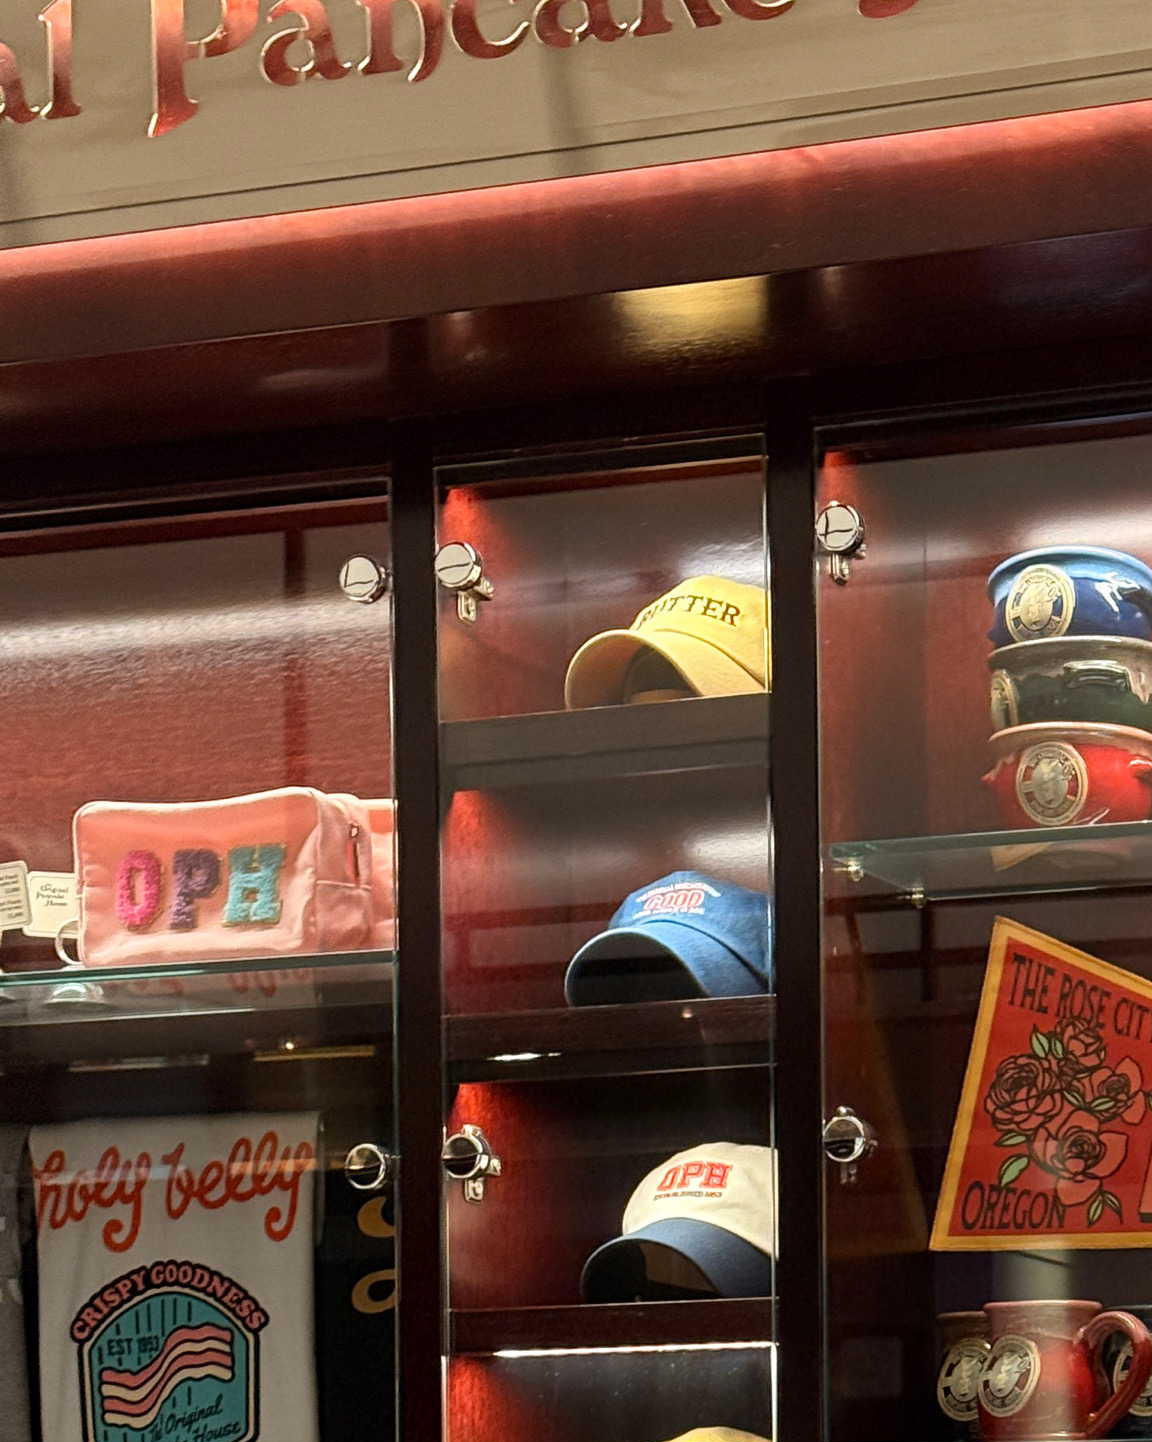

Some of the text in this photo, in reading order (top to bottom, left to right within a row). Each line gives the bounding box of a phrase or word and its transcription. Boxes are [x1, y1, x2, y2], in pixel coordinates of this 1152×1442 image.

[145, 0, 796, 137] Panca
[636, 594, 741, 632] BUTTER
[115, 843, 287, 933] OPH
[643, 888, 706, 911] GOOD
[1007, 953, 1050, 1012] THE
[1055, 978, 1110, 1026] ROSE
[33, 1146, 152, 1254] holy
[161, 1130, 315, 1243] belly
[656, 1161, 733, 1191] OPH
[961, 1179, 1069, 1231] OREGON
[72, 1264, 267, 1341] CRISPY GOODNESS
[106, 1338, 133, 1356] EST
[164, 1393, 224, 1436] Original
